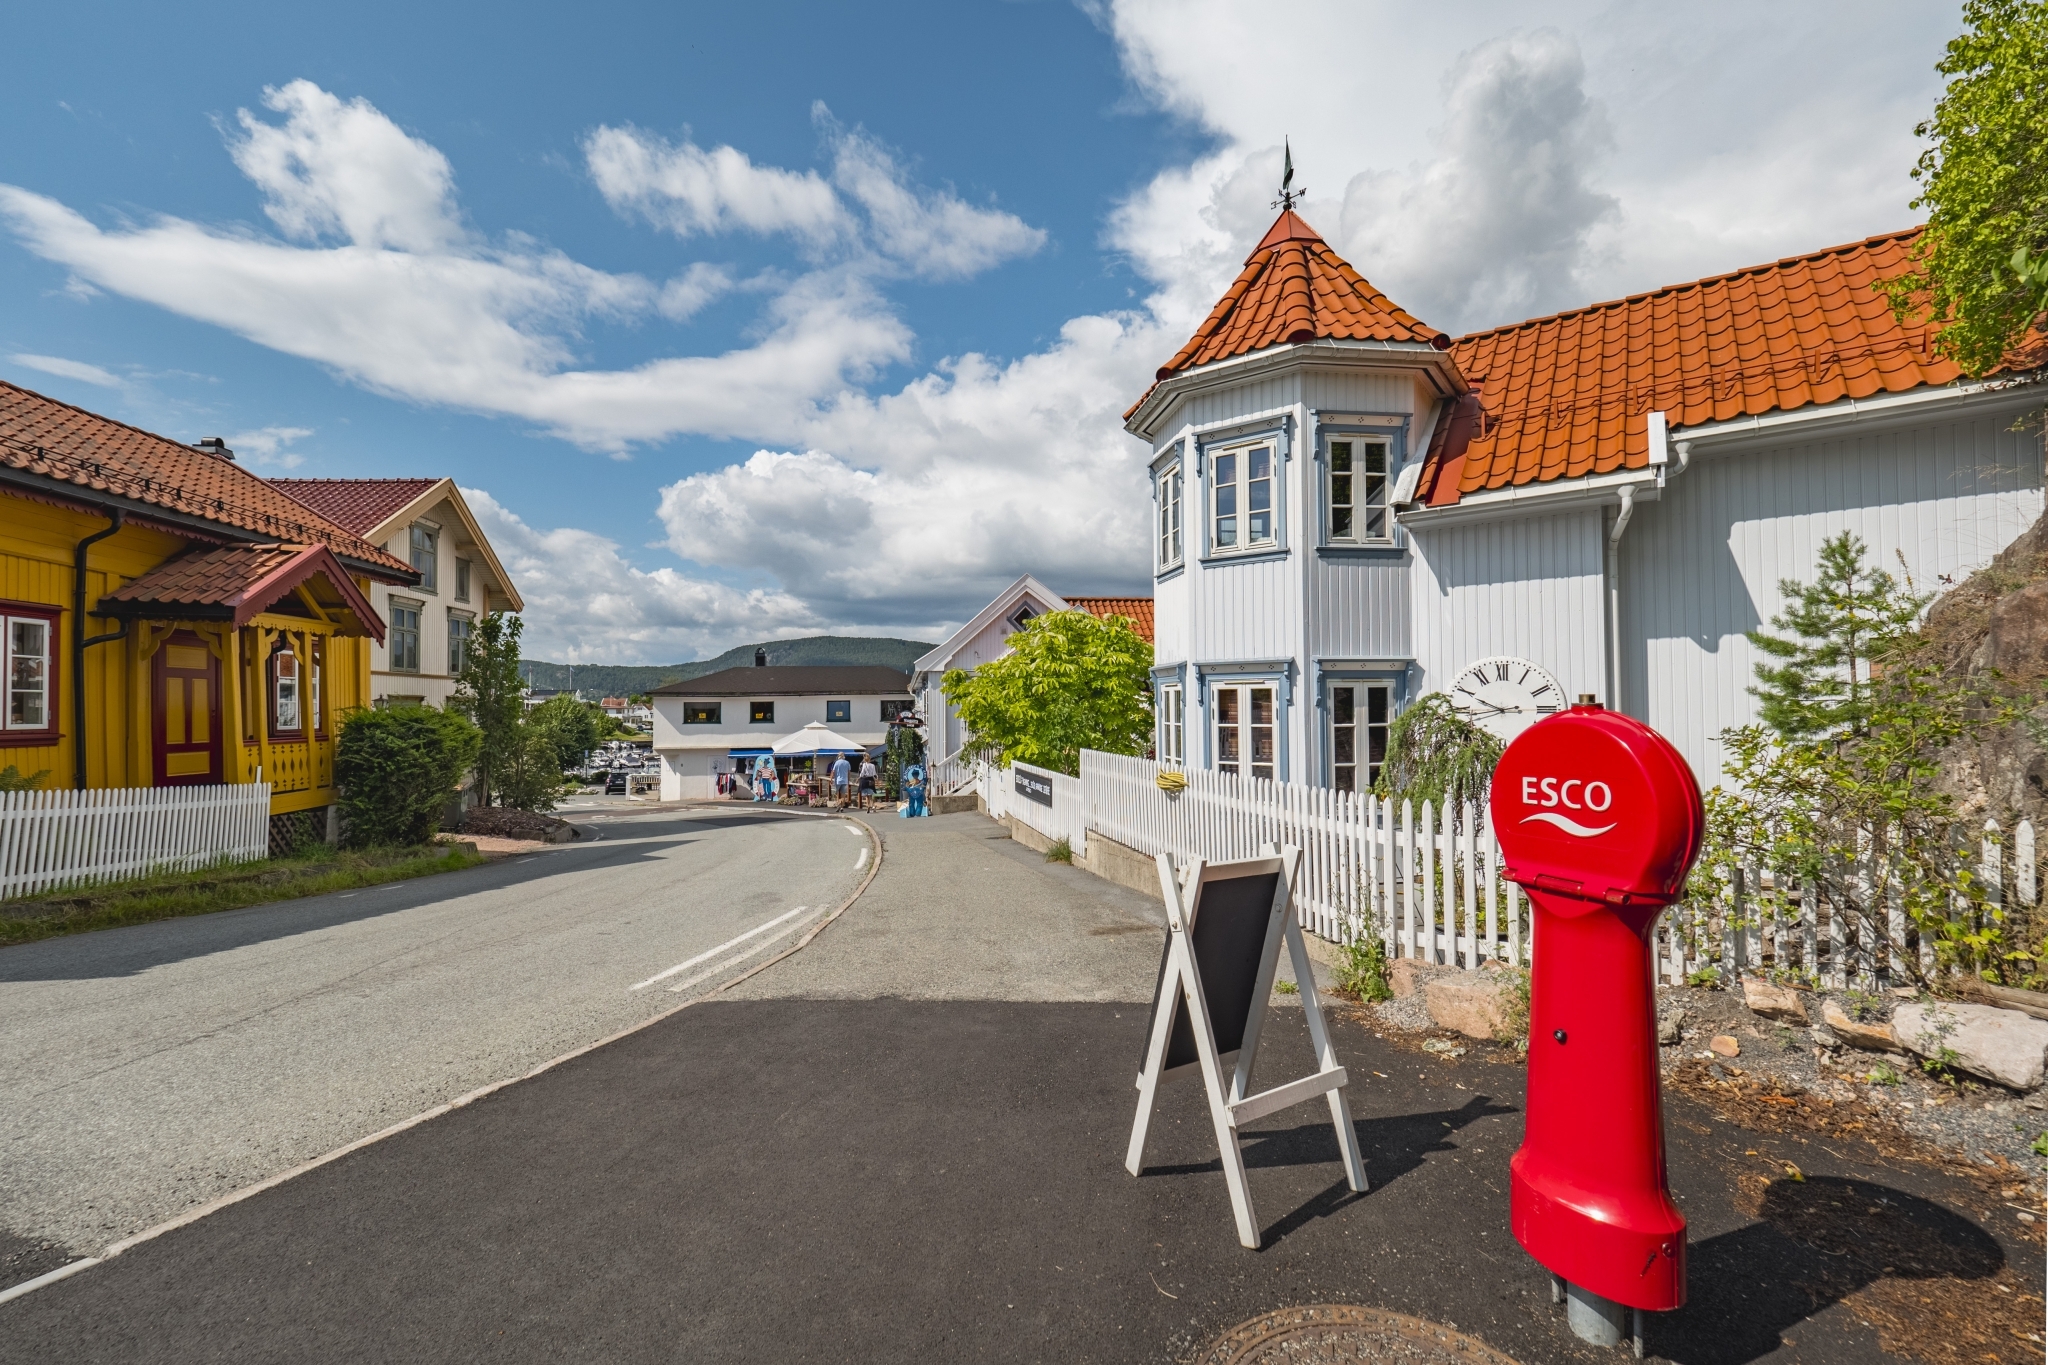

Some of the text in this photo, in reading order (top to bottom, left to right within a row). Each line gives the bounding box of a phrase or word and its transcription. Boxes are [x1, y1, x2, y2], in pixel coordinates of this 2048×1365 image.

[1473, 668, 1490, 687] XI
[1495, 664, 1510, 682] XII
[1517, 668, 1531, 685] I
[1457, 685, 1477, 698] X
[1530, 684, 1551, 698] II
[1536, 704, 1557, 715] III
[1522, 776, 1612, 812] ESCO
